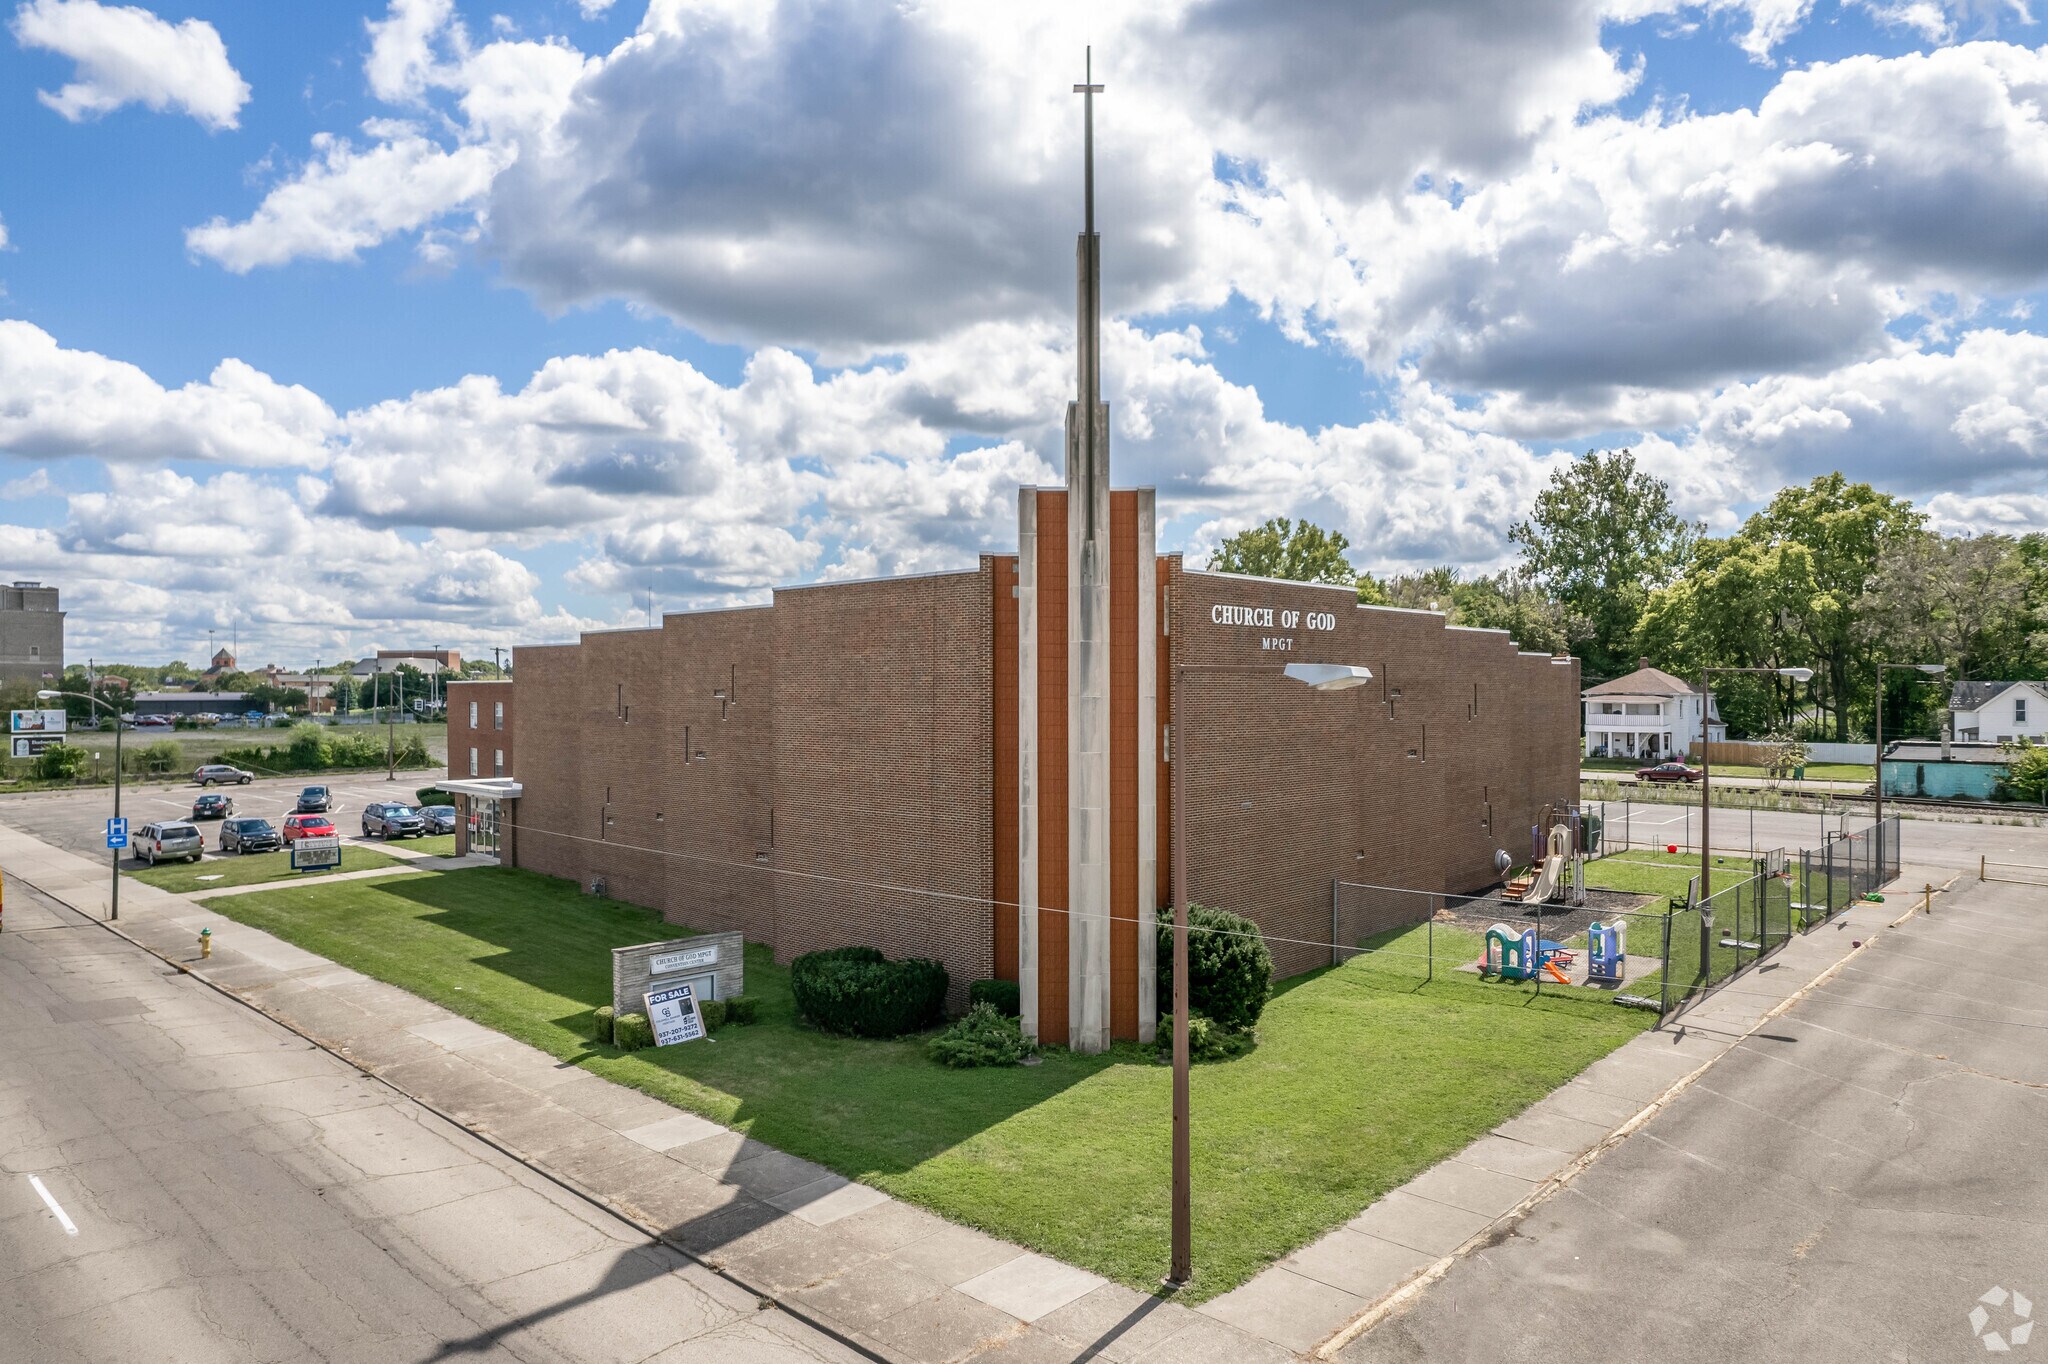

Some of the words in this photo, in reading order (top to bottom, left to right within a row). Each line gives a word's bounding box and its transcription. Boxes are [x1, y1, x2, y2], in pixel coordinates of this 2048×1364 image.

[1211, 604, 1274, 627] CHURCH
[1281, 610, 1300, 628] OF
[1306, 612, 1336, 631] GOD
[1262, 637, 1293, 651] MPGT
[110, 819, 125, 834] H
[656, 956, 678, 965] CHURCH
[697, 950, 712, 958] MPGT
[649, 993, 667, 1004] FOR
[668, 987, 689, 999] SALE
[658, 1023, 698, 1038] 937-207-9272
